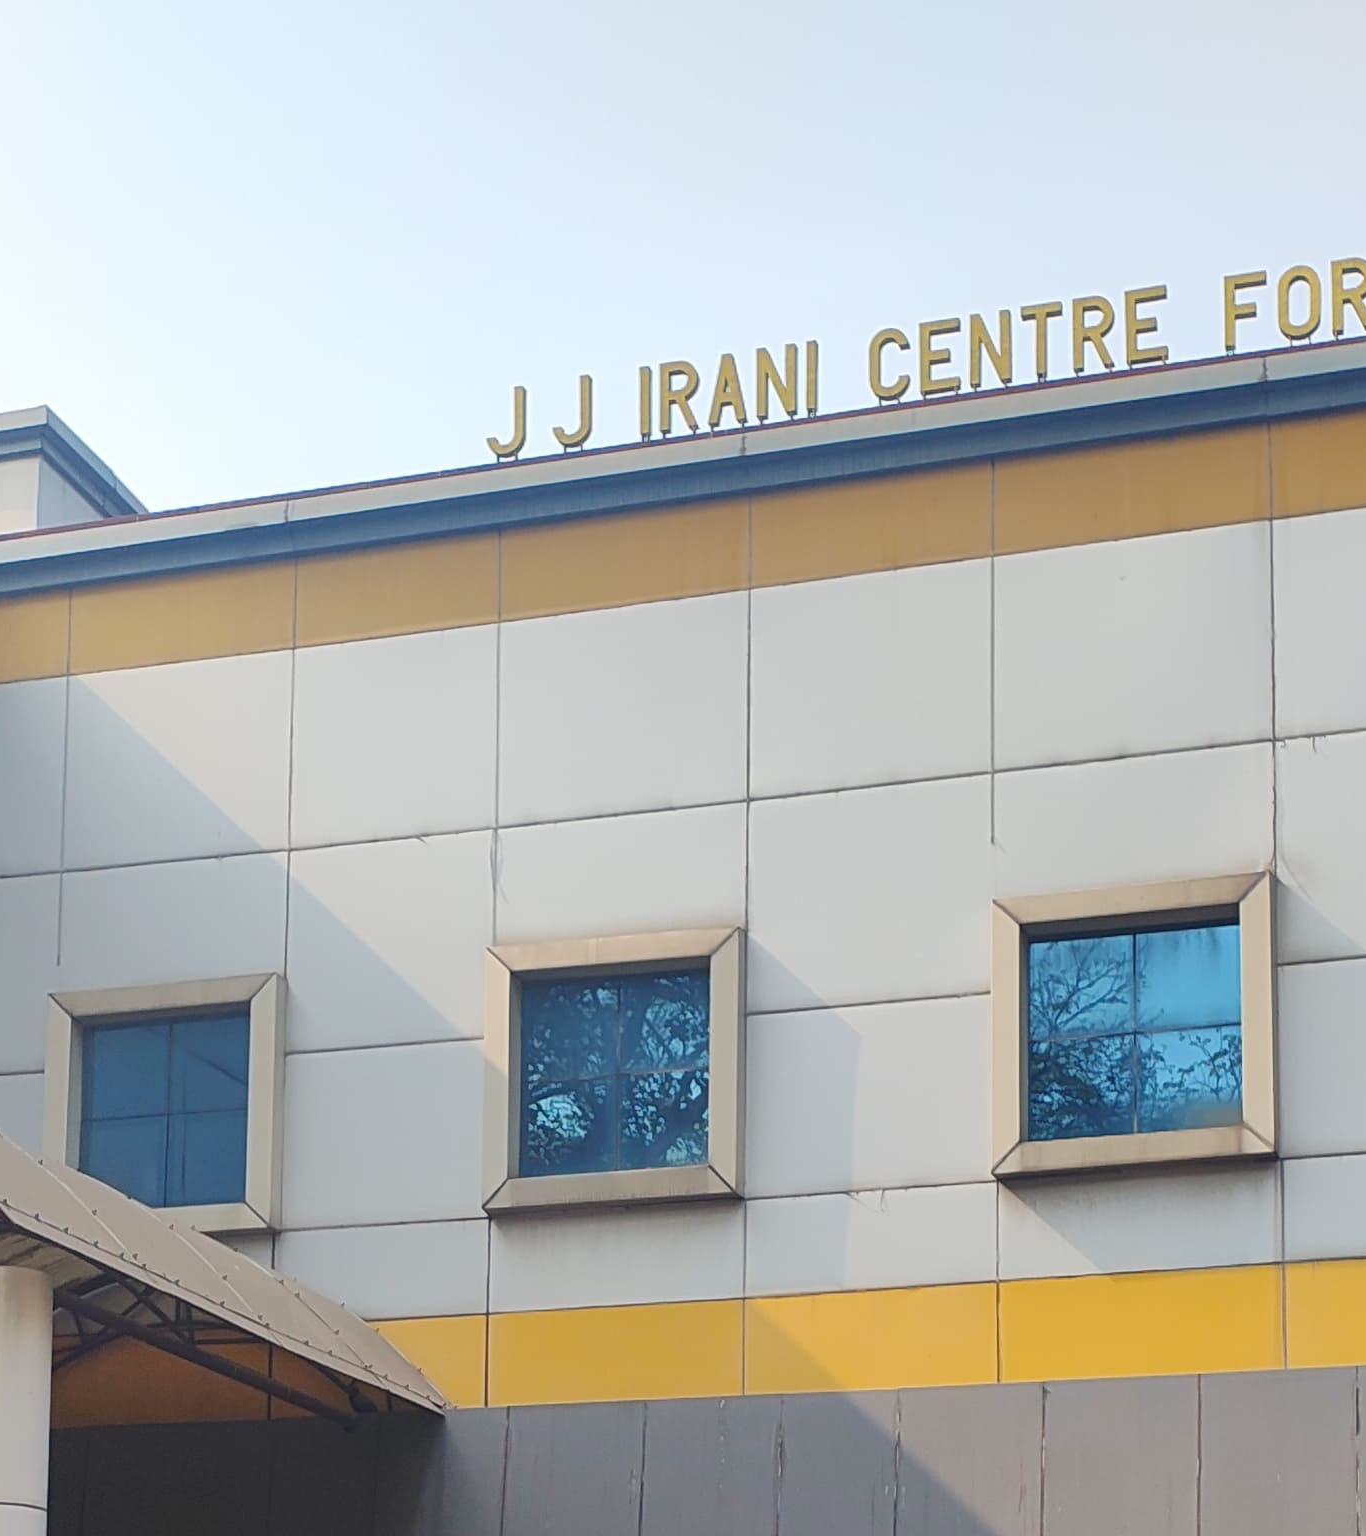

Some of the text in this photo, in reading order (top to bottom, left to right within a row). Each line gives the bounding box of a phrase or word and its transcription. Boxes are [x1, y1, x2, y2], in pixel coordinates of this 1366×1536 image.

[486, 385, 526, 460] J
[552, 374, 592, 450] J
[637, 340, 819, 438] IRANI
[867, 284, 1168, 402] CENTRE
